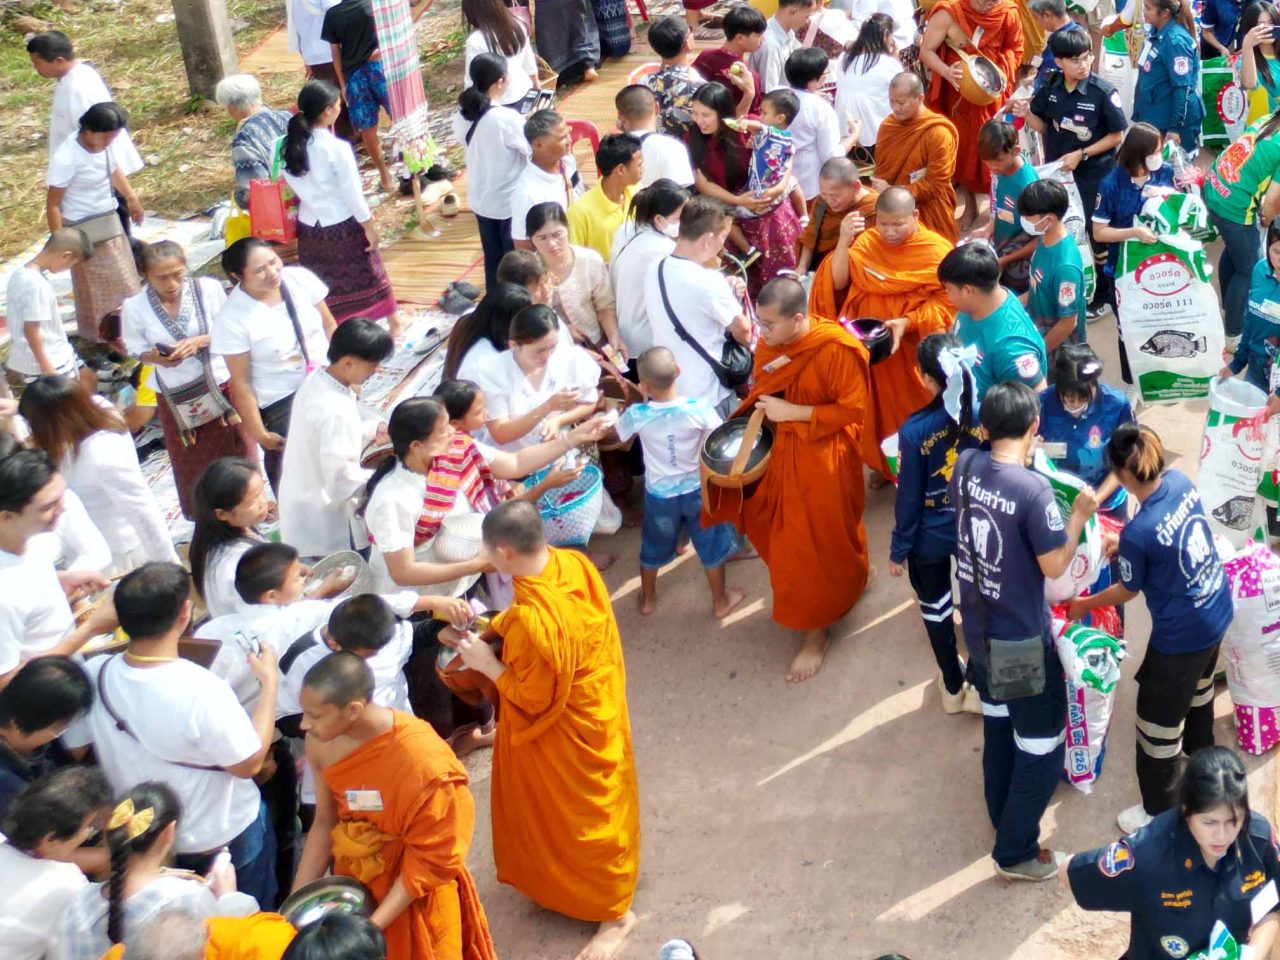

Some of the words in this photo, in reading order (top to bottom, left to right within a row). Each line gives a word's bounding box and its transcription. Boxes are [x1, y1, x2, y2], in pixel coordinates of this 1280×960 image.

[1142, 297, 1172, 310] อวอร์ด
[1176, 298, 1193, 308] 111
